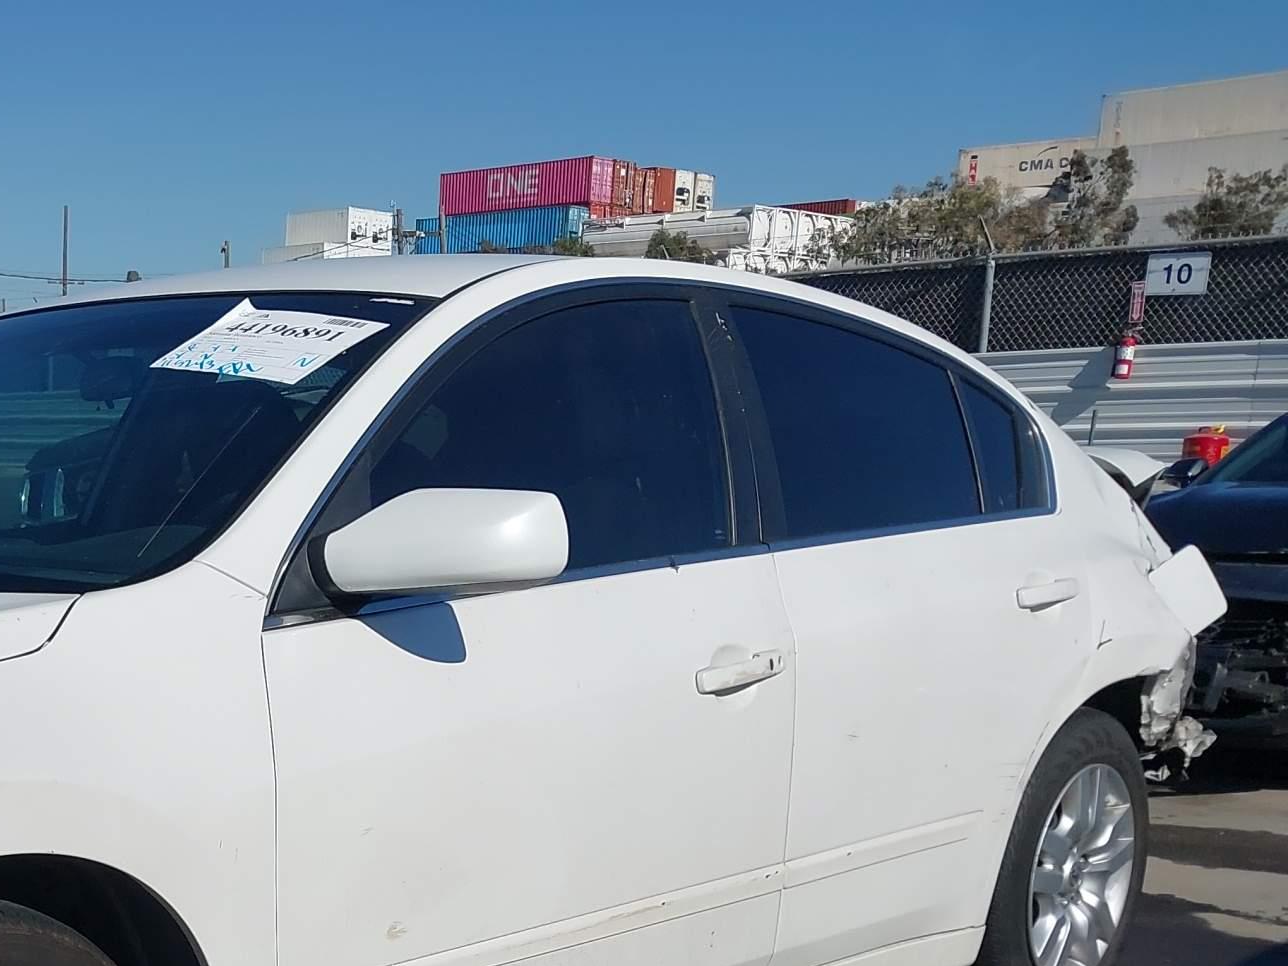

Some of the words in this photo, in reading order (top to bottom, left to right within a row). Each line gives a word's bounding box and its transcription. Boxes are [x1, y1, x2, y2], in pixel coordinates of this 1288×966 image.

[1018, 158, 1054, 172] CMA
[488, 168, 539, 199] ONE
[1163, 263, 1193, 285] 10
[225, 321, 346, 342] 44196891
